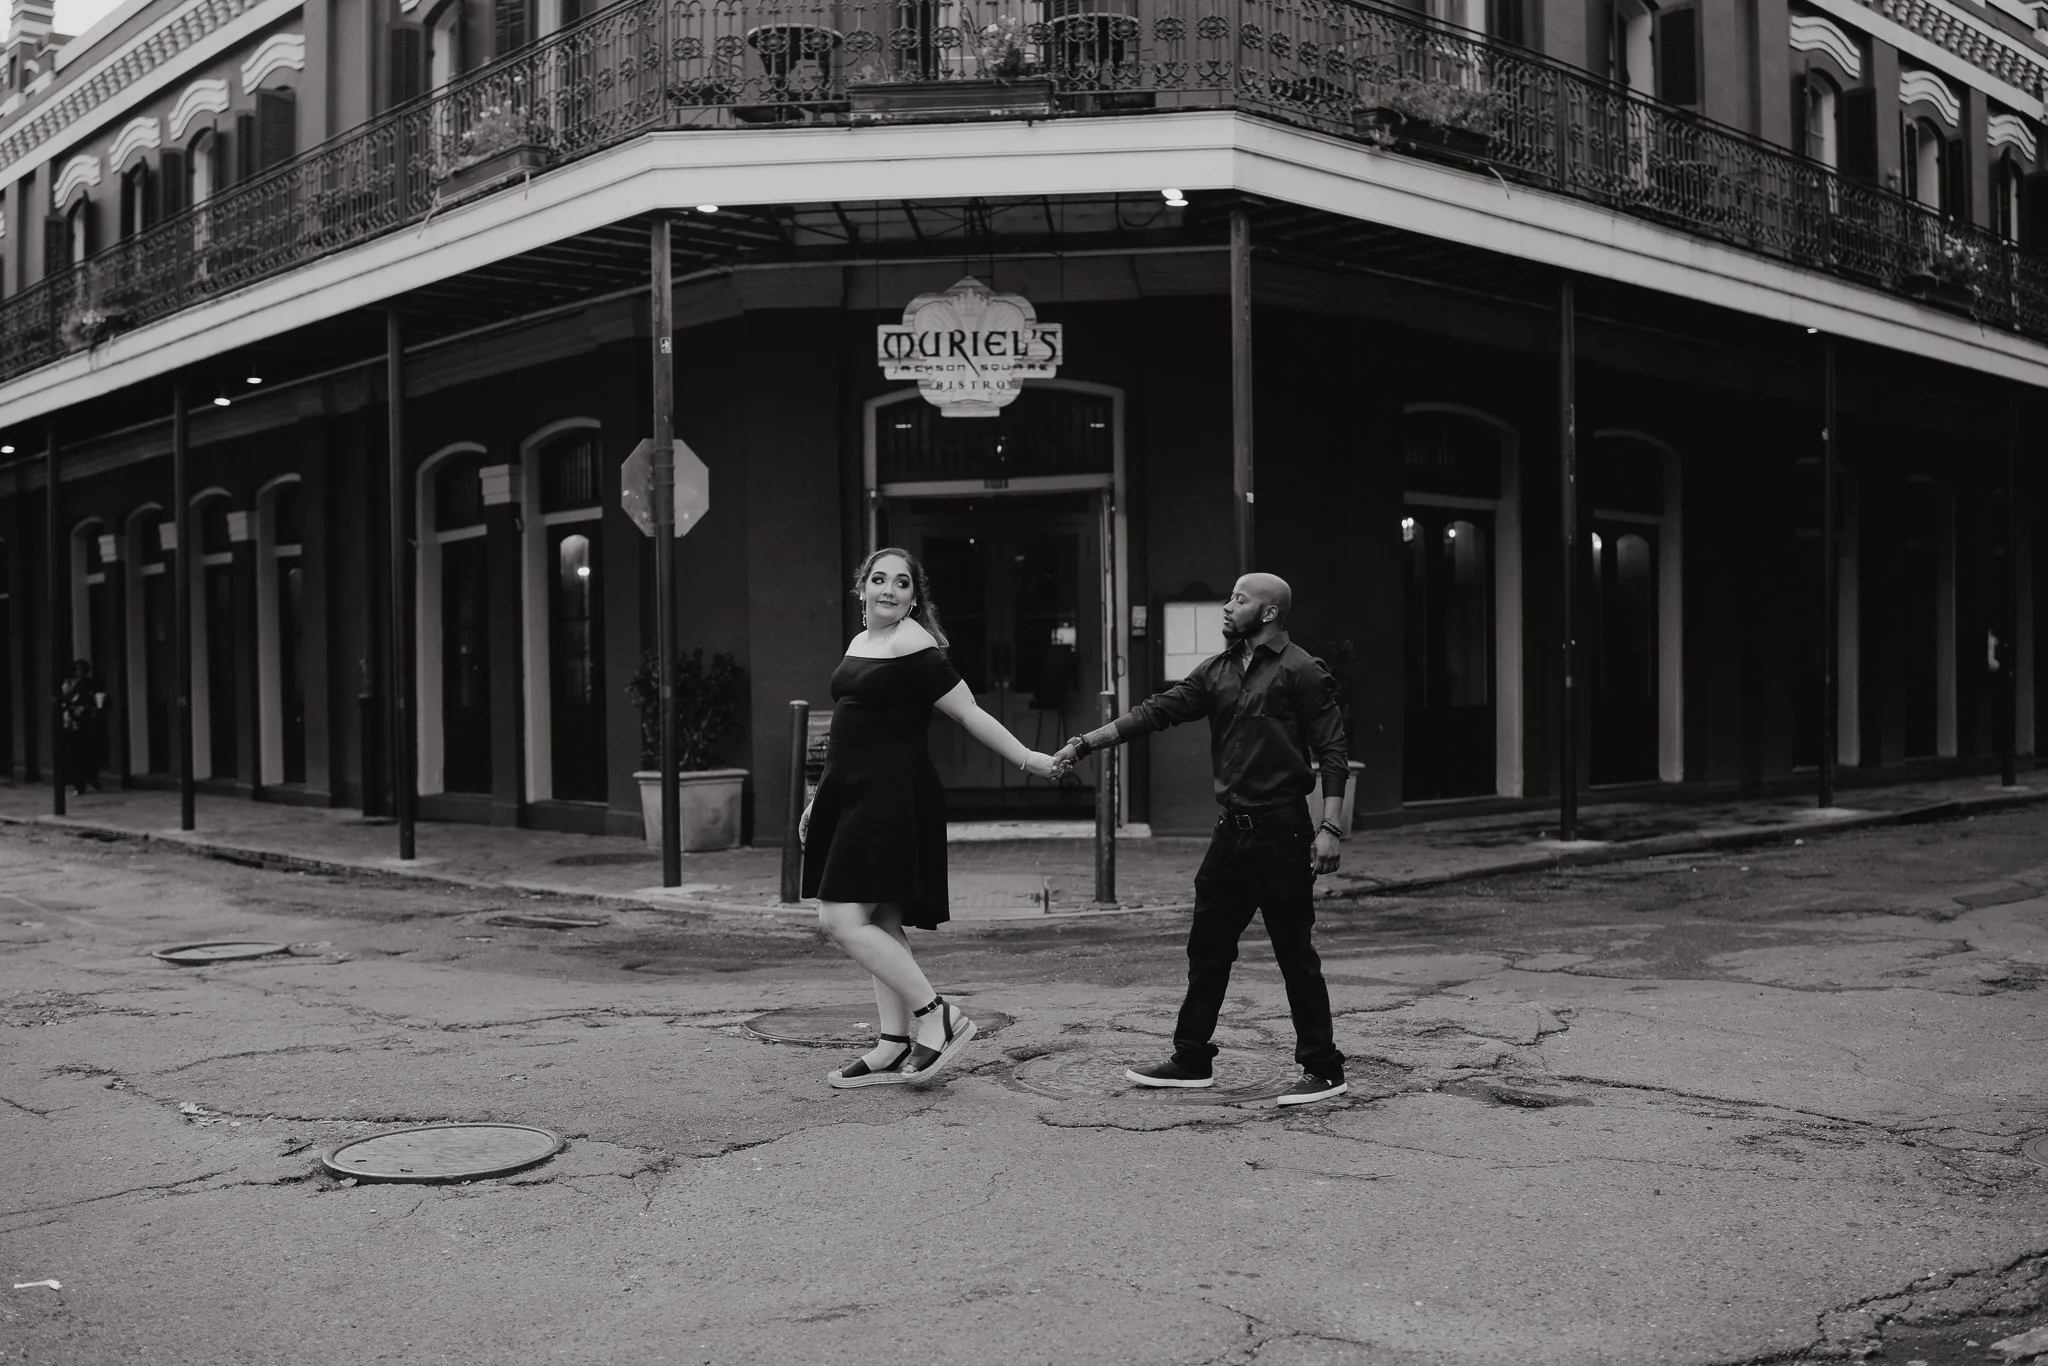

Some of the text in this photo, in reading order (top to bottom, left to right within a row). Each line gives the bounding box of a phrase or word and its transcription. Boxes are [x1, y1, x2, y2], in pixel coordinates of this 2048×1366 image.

[884, 329, 1059, 376] MURIEL'S
[893, 363, 1049, 374] JACKSON SQUARE
[935, 380, 1006, 391] BISTRO
